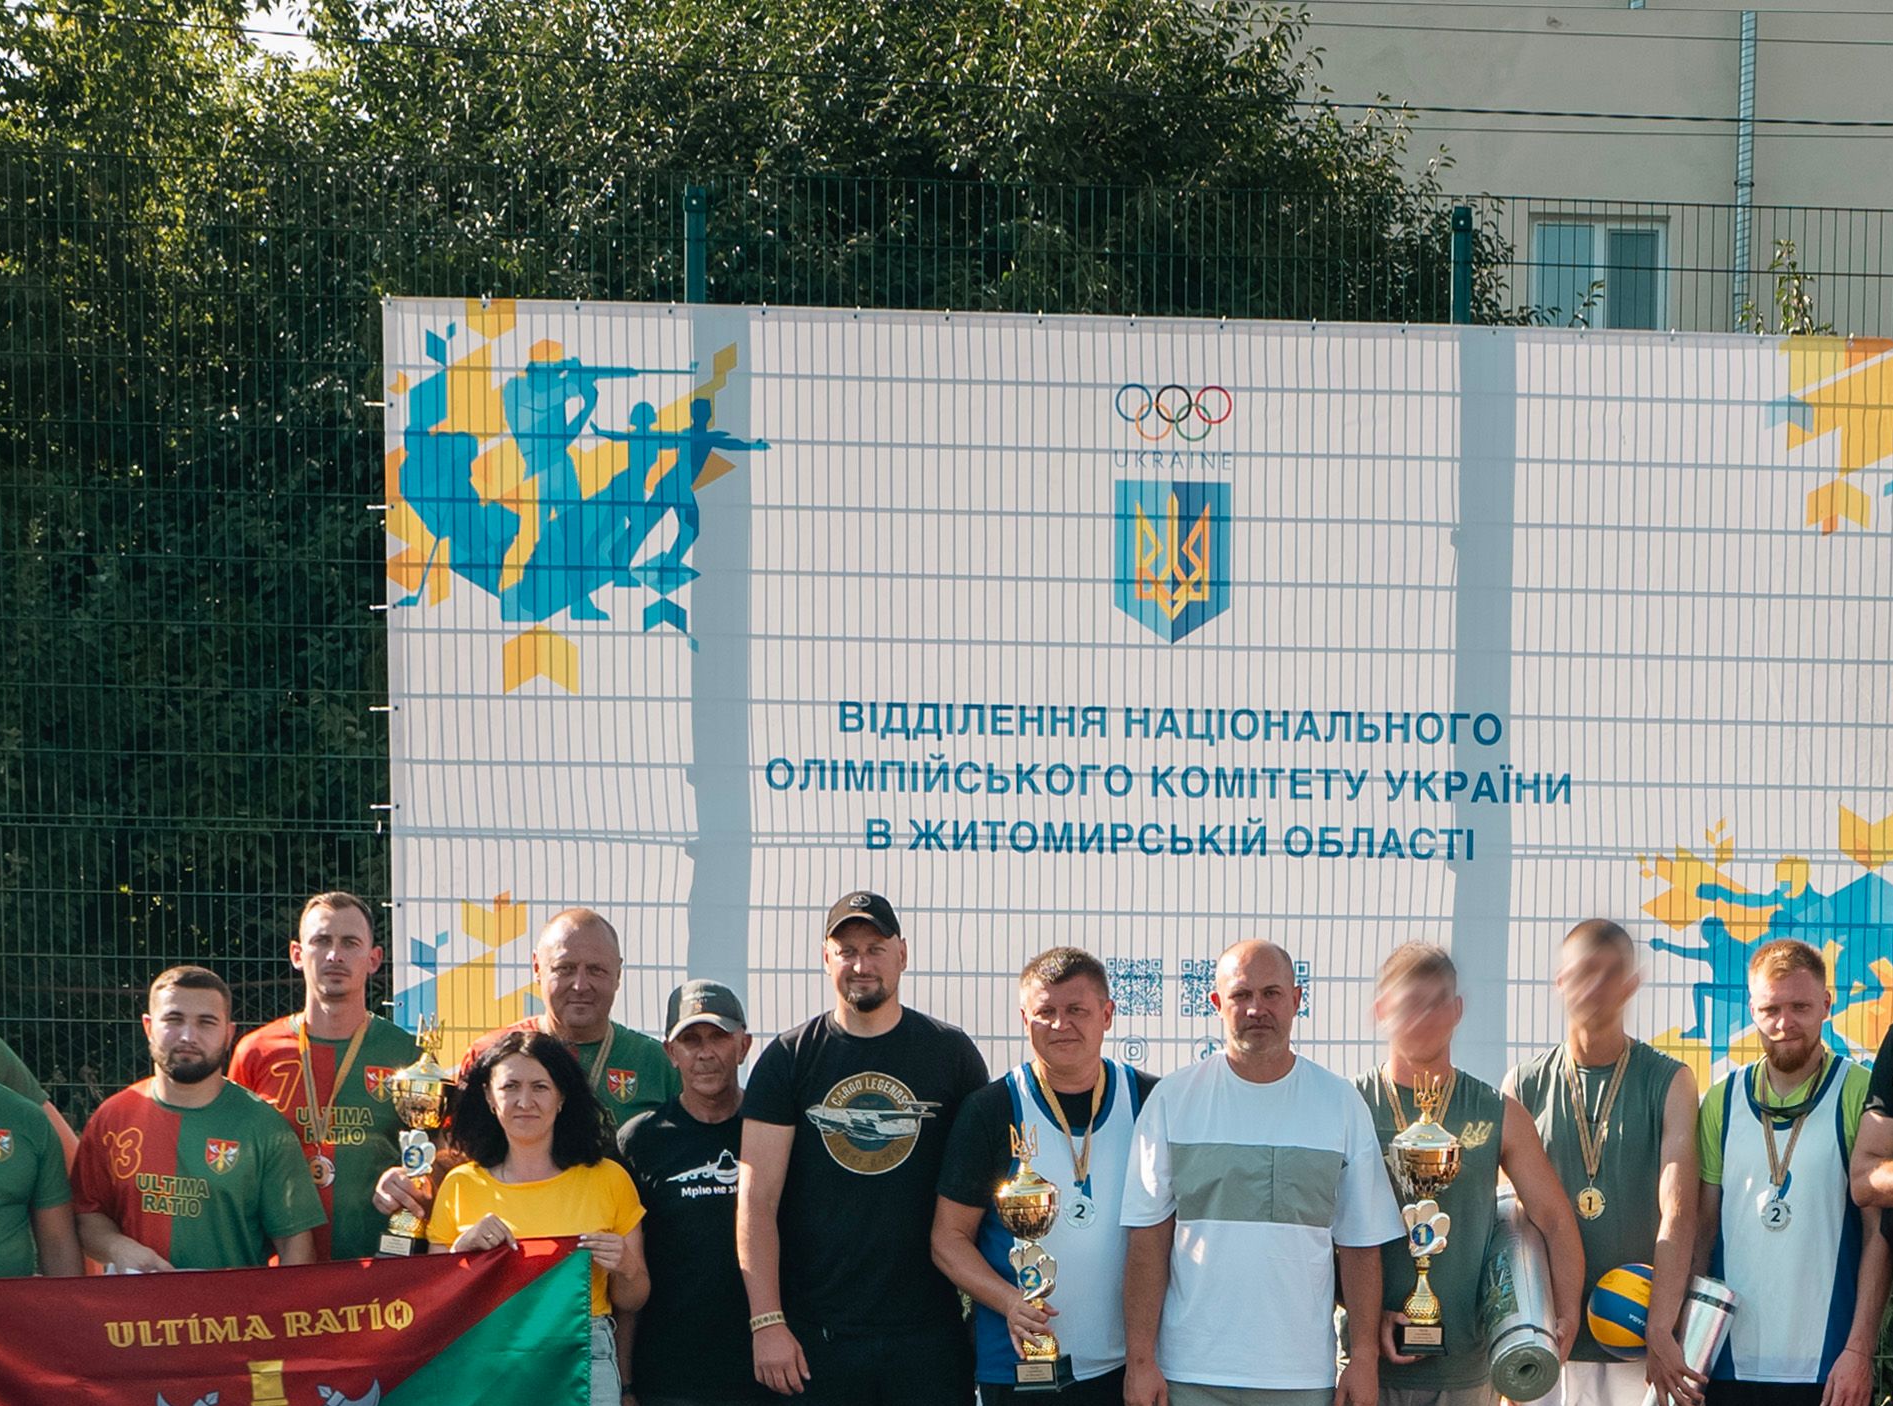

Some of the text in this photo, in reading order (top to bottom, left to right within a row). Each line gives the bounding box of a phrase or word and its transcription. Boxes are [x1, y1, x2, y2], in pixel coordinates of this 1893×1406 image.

[1114, 450, 1232, 471] UKRAINE
[838, 700, 1503, 746] ВІДДІЛЕННЯ НАЦІОНАЛЬНОГО
[765, 753, 1572, 804] ОЛІМПІЙСЬКОГО КОМІТЕТУ УКРАЇНИ
[866, 817, 1475, 861] В ЖИТОМИРСЬКІЙ ОБЛАСТІ
[865, 1077, 909, 1105] LEGENDS
[296, 1107, 374, 1126] UIMA
[136, 1173, 209, 1198] ULTIMA
[142, 1194, 202, 1217] RATIO
[1074, 1204, 1085, 1219] 2
[1770, 1208, 1781, 1222] 2
